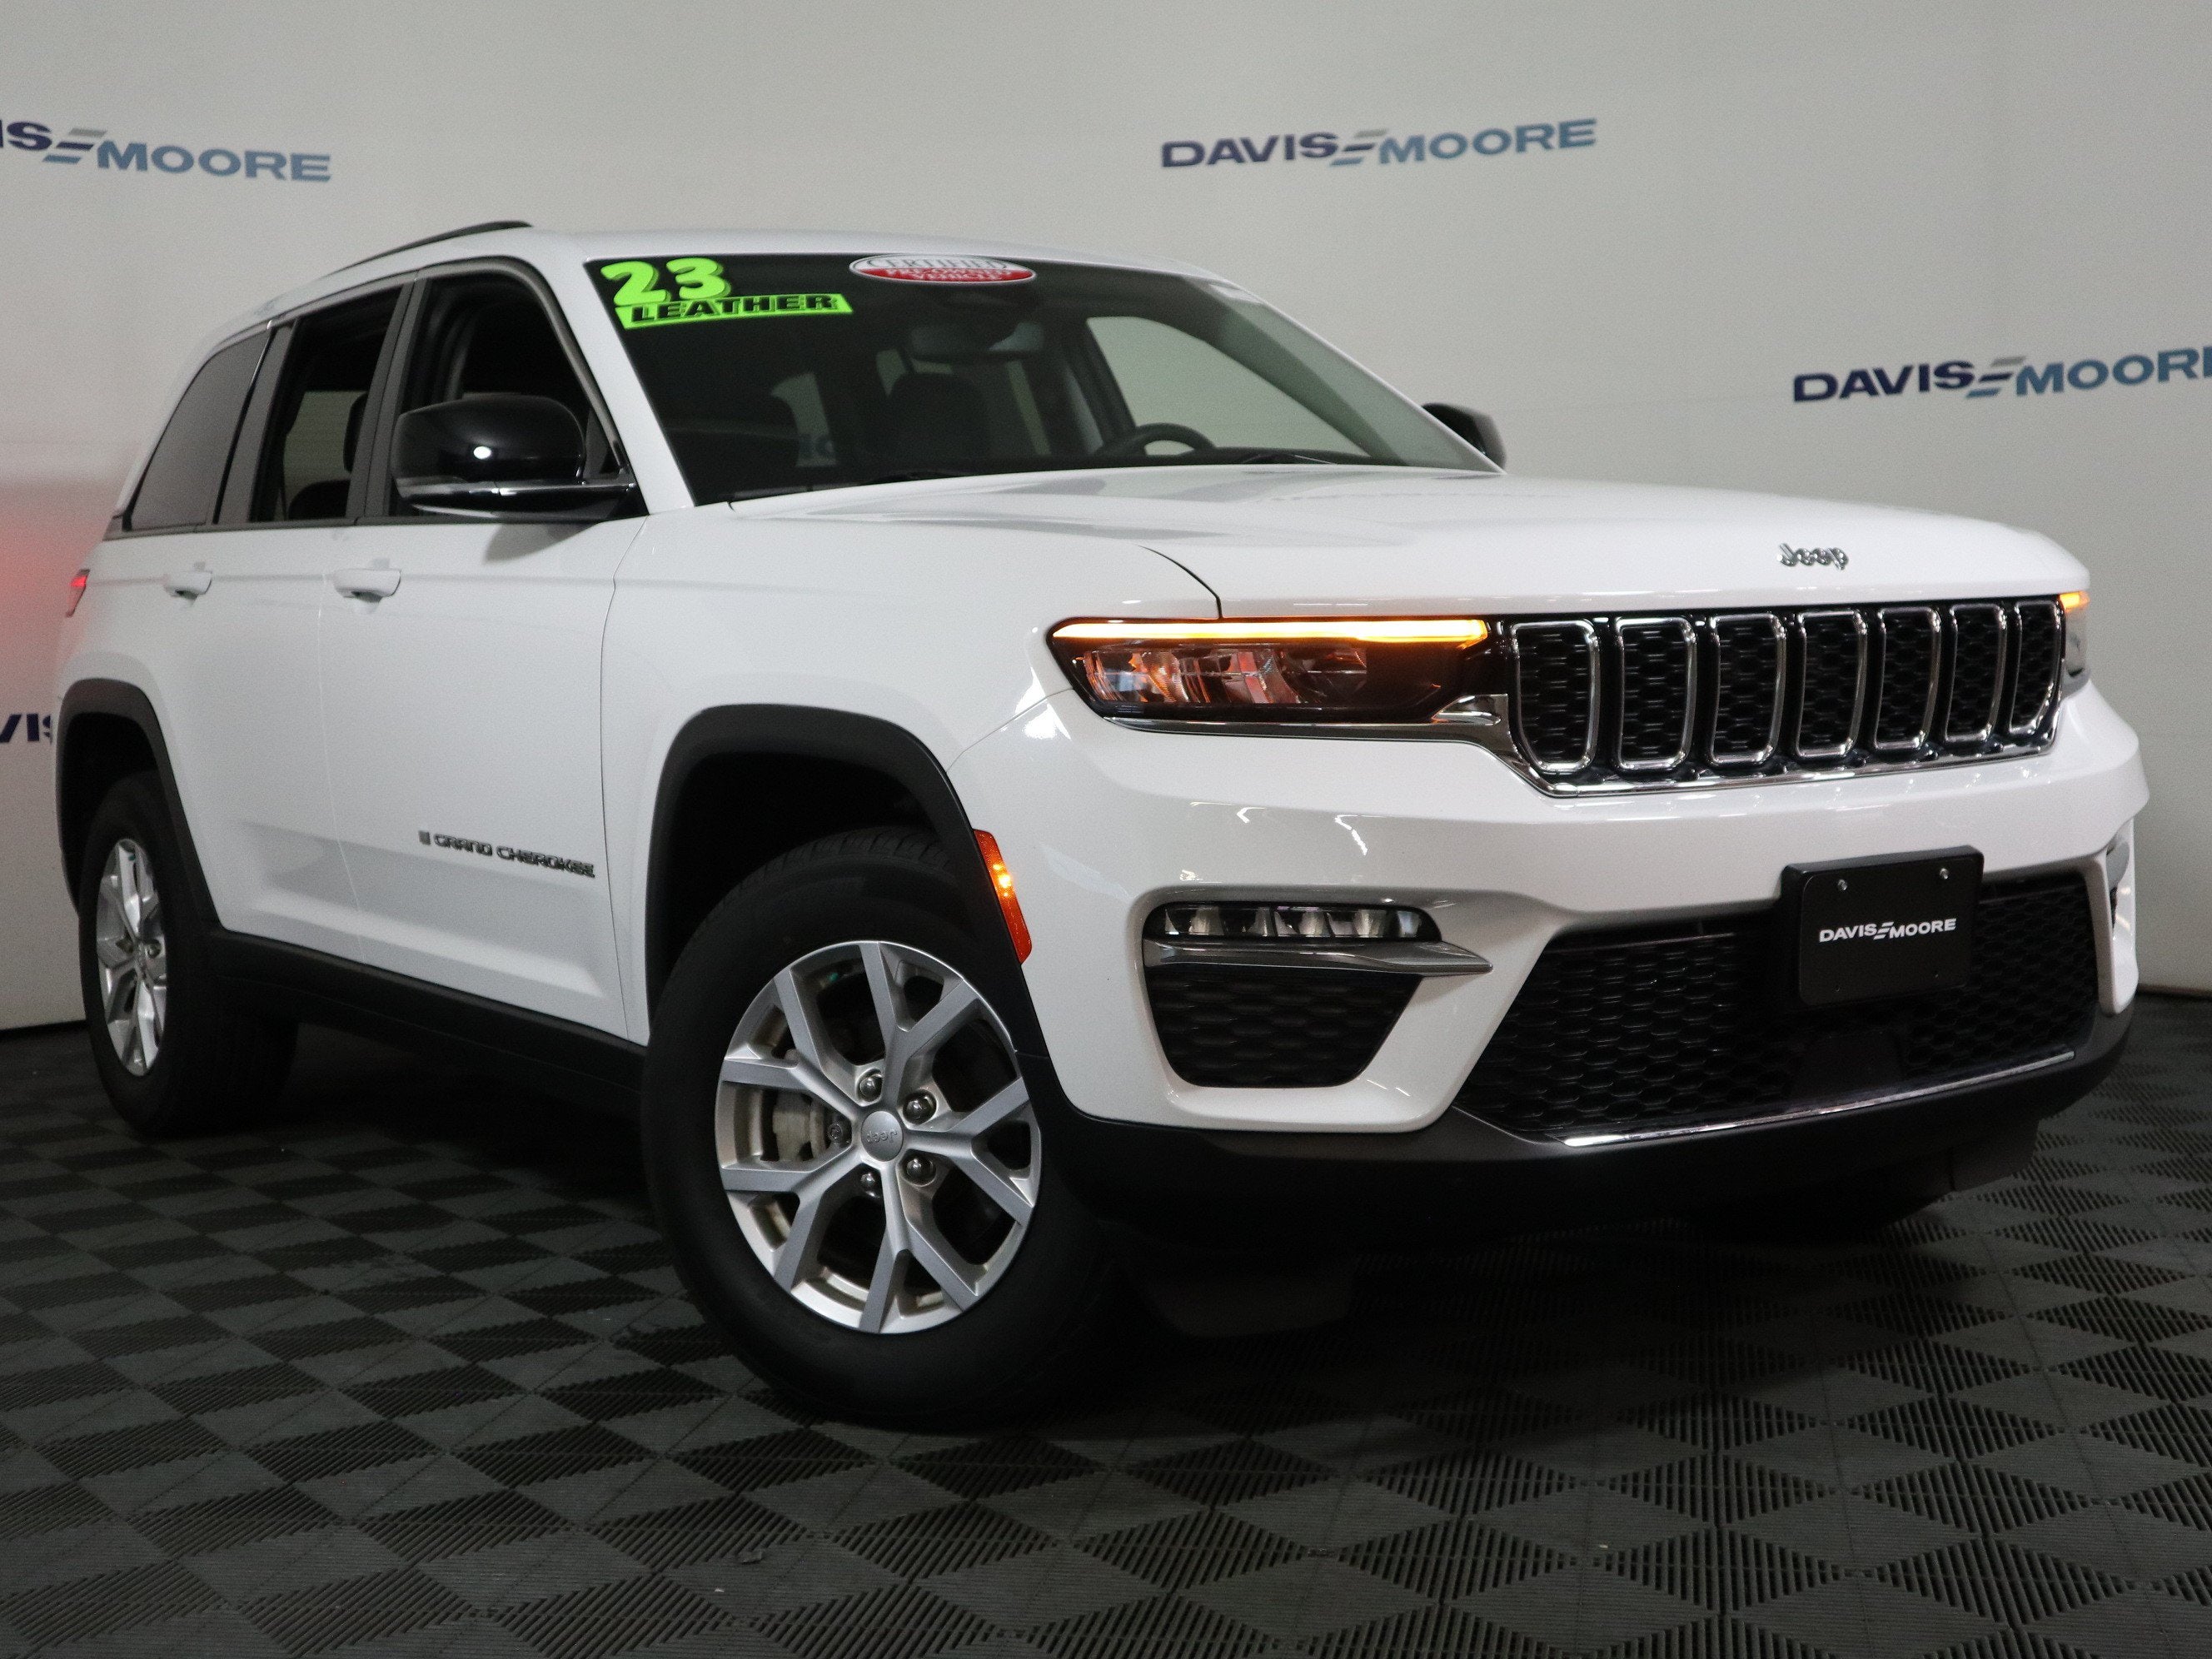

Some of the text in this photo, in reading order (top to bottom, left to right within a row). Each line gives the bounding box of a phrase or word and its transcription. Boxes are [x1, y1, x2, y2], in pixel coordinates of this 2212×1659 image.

[97, 140, 331, 182] MOORE
[1161, 118, 1597, 167] DAVIS MOORE
[600, 257, 732, 306] 23
[630, 294, 838, 323] LEATHER
[1792, 346, 2212, 402] DAVIS MOOR
[1776, 542, 1850, 570] Jeep
[433, 833, 595, 879] GRAND CHEROKEE
[1819, 918, 1957, 943] DAVIS MOORE
